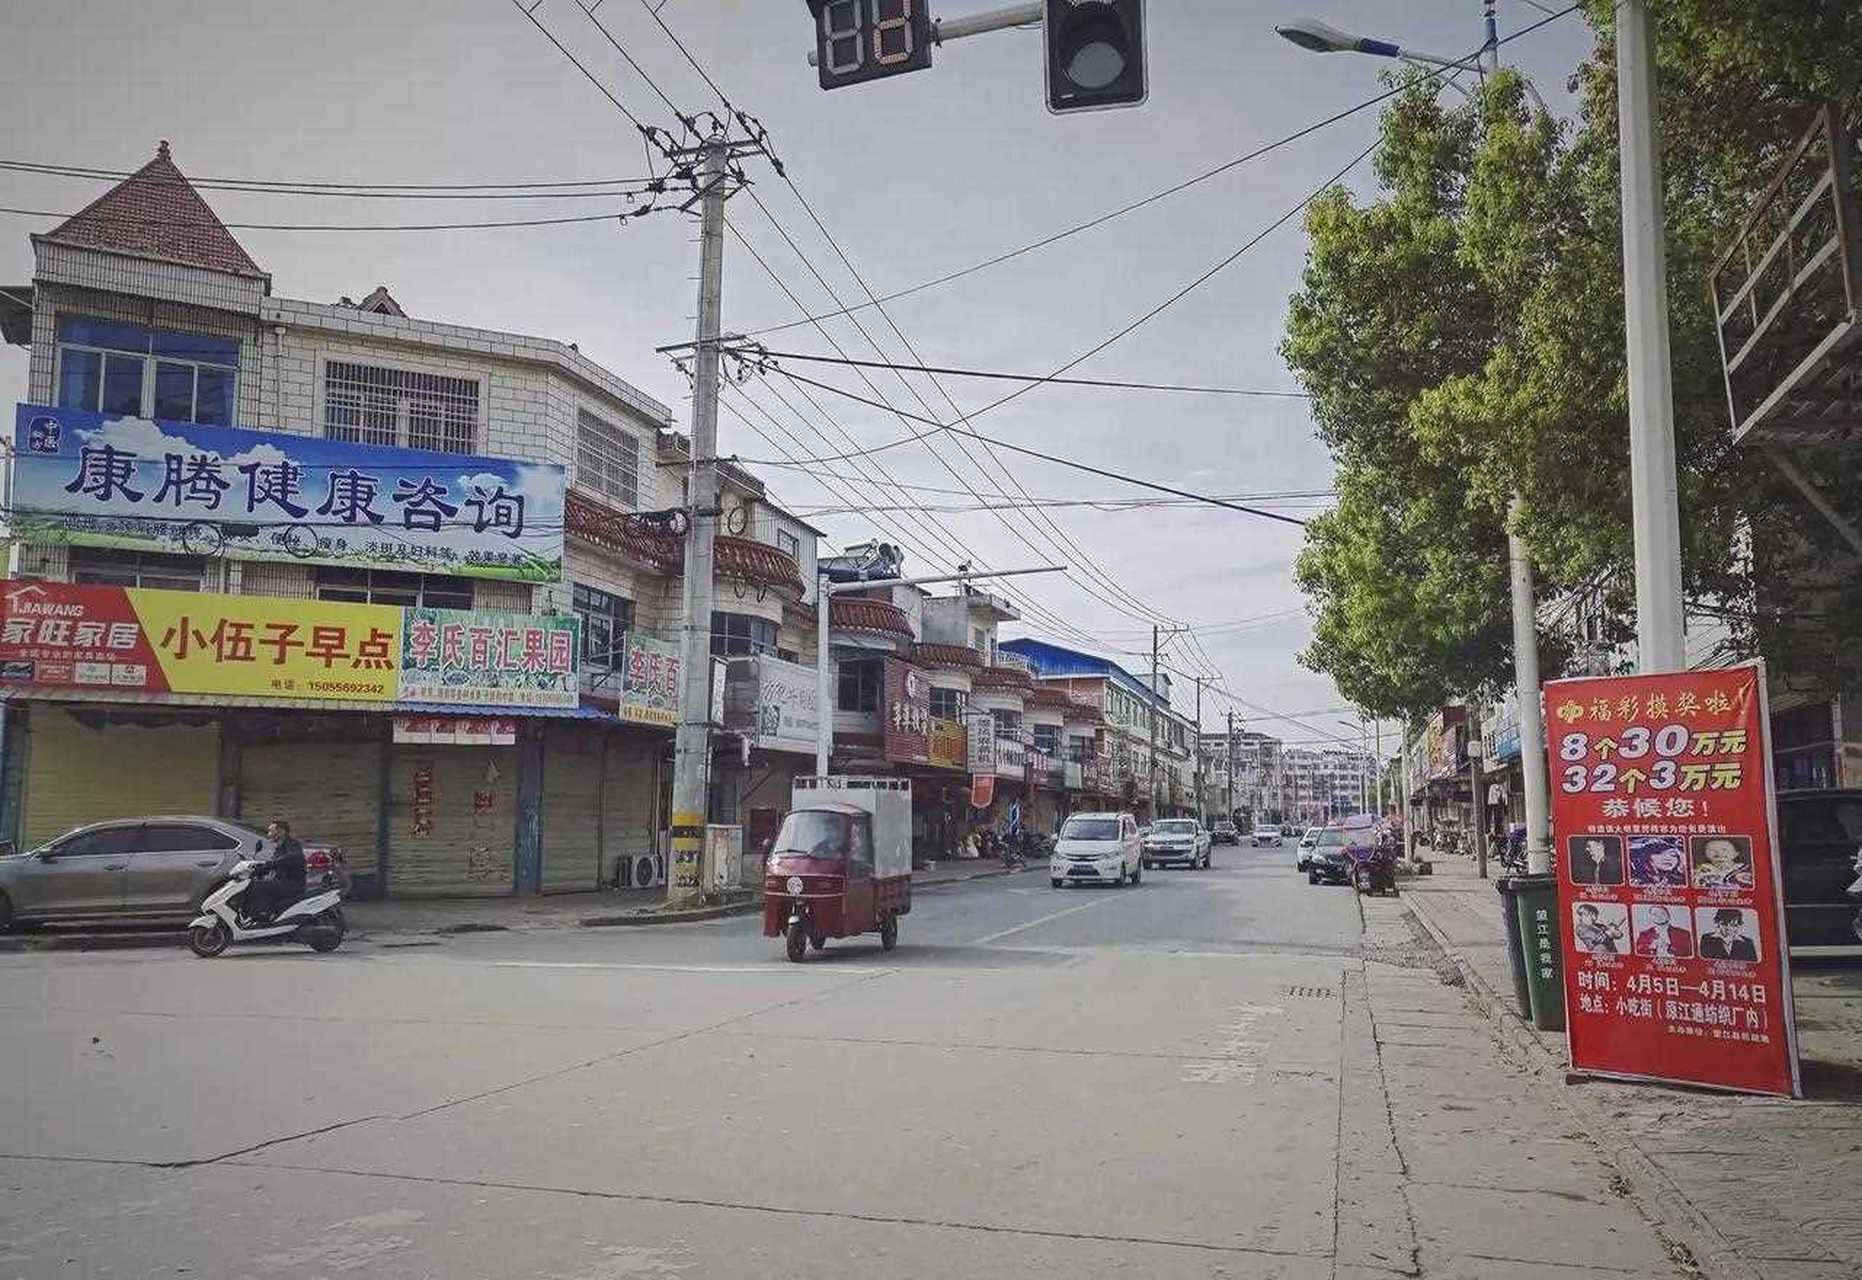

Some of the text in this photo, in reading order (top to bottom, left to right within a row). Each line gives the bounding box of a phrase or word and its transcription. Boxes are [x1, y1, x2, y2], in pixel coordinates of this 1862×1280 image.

[65, 444, 526, 538] 康腾健康咨询
[1, 618, 139, 649] 家旺家居
[160, 616, 394, 670] 小伍子早点
[411, 620, 573, 676] 李氏百汇果园
[1560, 724, 1747, 762] 8个30万元
[1561, 760, 1742, 794] 32个3万元
